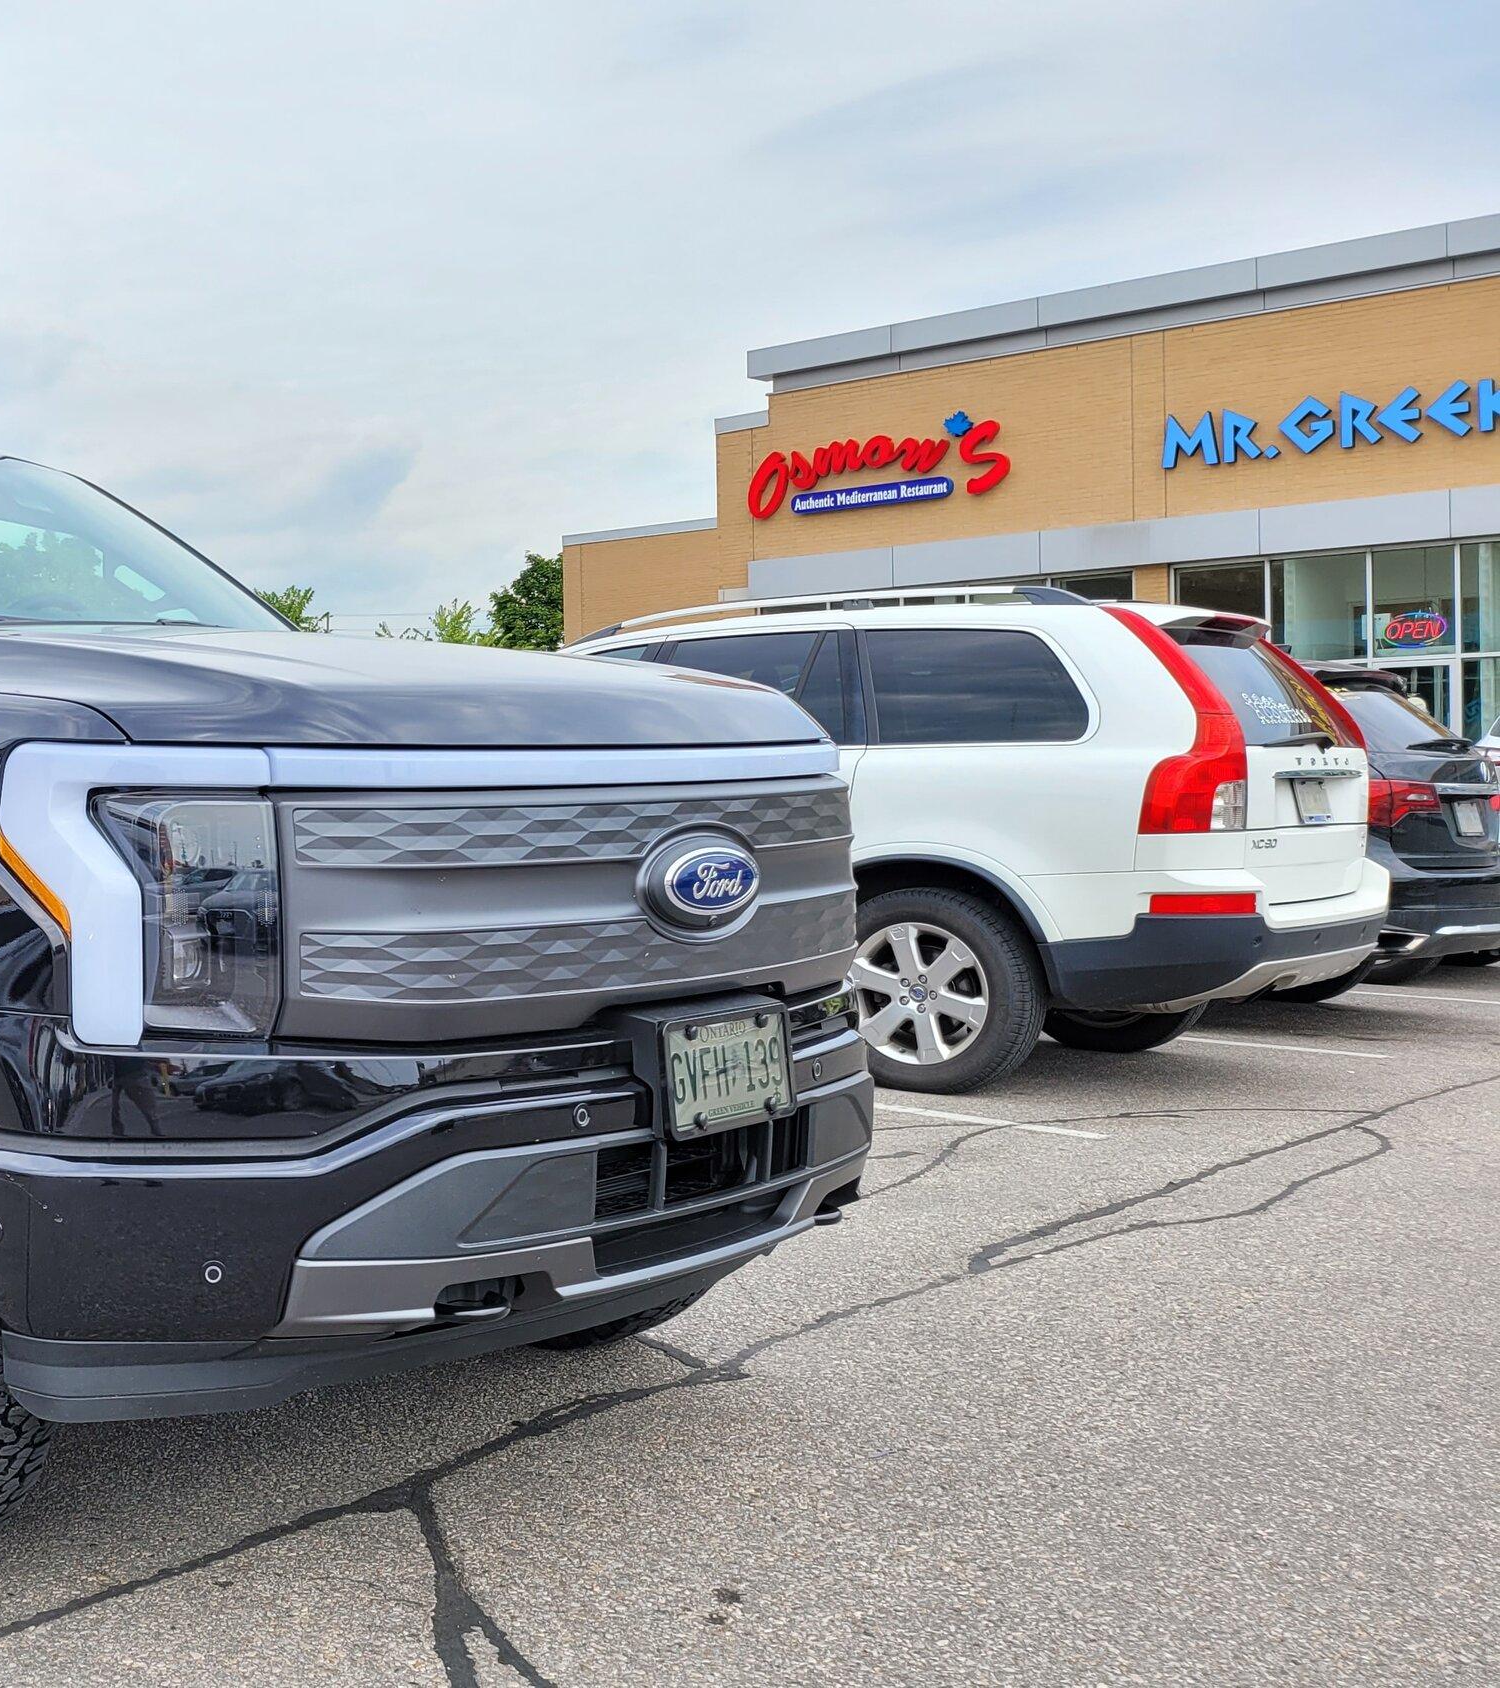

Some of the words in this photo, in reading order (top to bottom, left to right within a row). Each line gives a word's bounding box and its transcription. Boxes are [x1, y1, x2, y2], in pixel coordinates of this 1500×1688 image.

[1161, 408, 1281, 470] MR.
[794, 493, 834, 511] Authentic
[836, 487, 898, 506] Mediterranean
[899, 481, 948, 499] Restaurant
[1386, 620, 1442, 640] OPEN
[692, 862, 742, 900] Ford
[699, 1020, 746, 1043] ONTARIO
[743, 1036, 783, 1093] 139
[708, 1105, 729, 1118] GREEN
